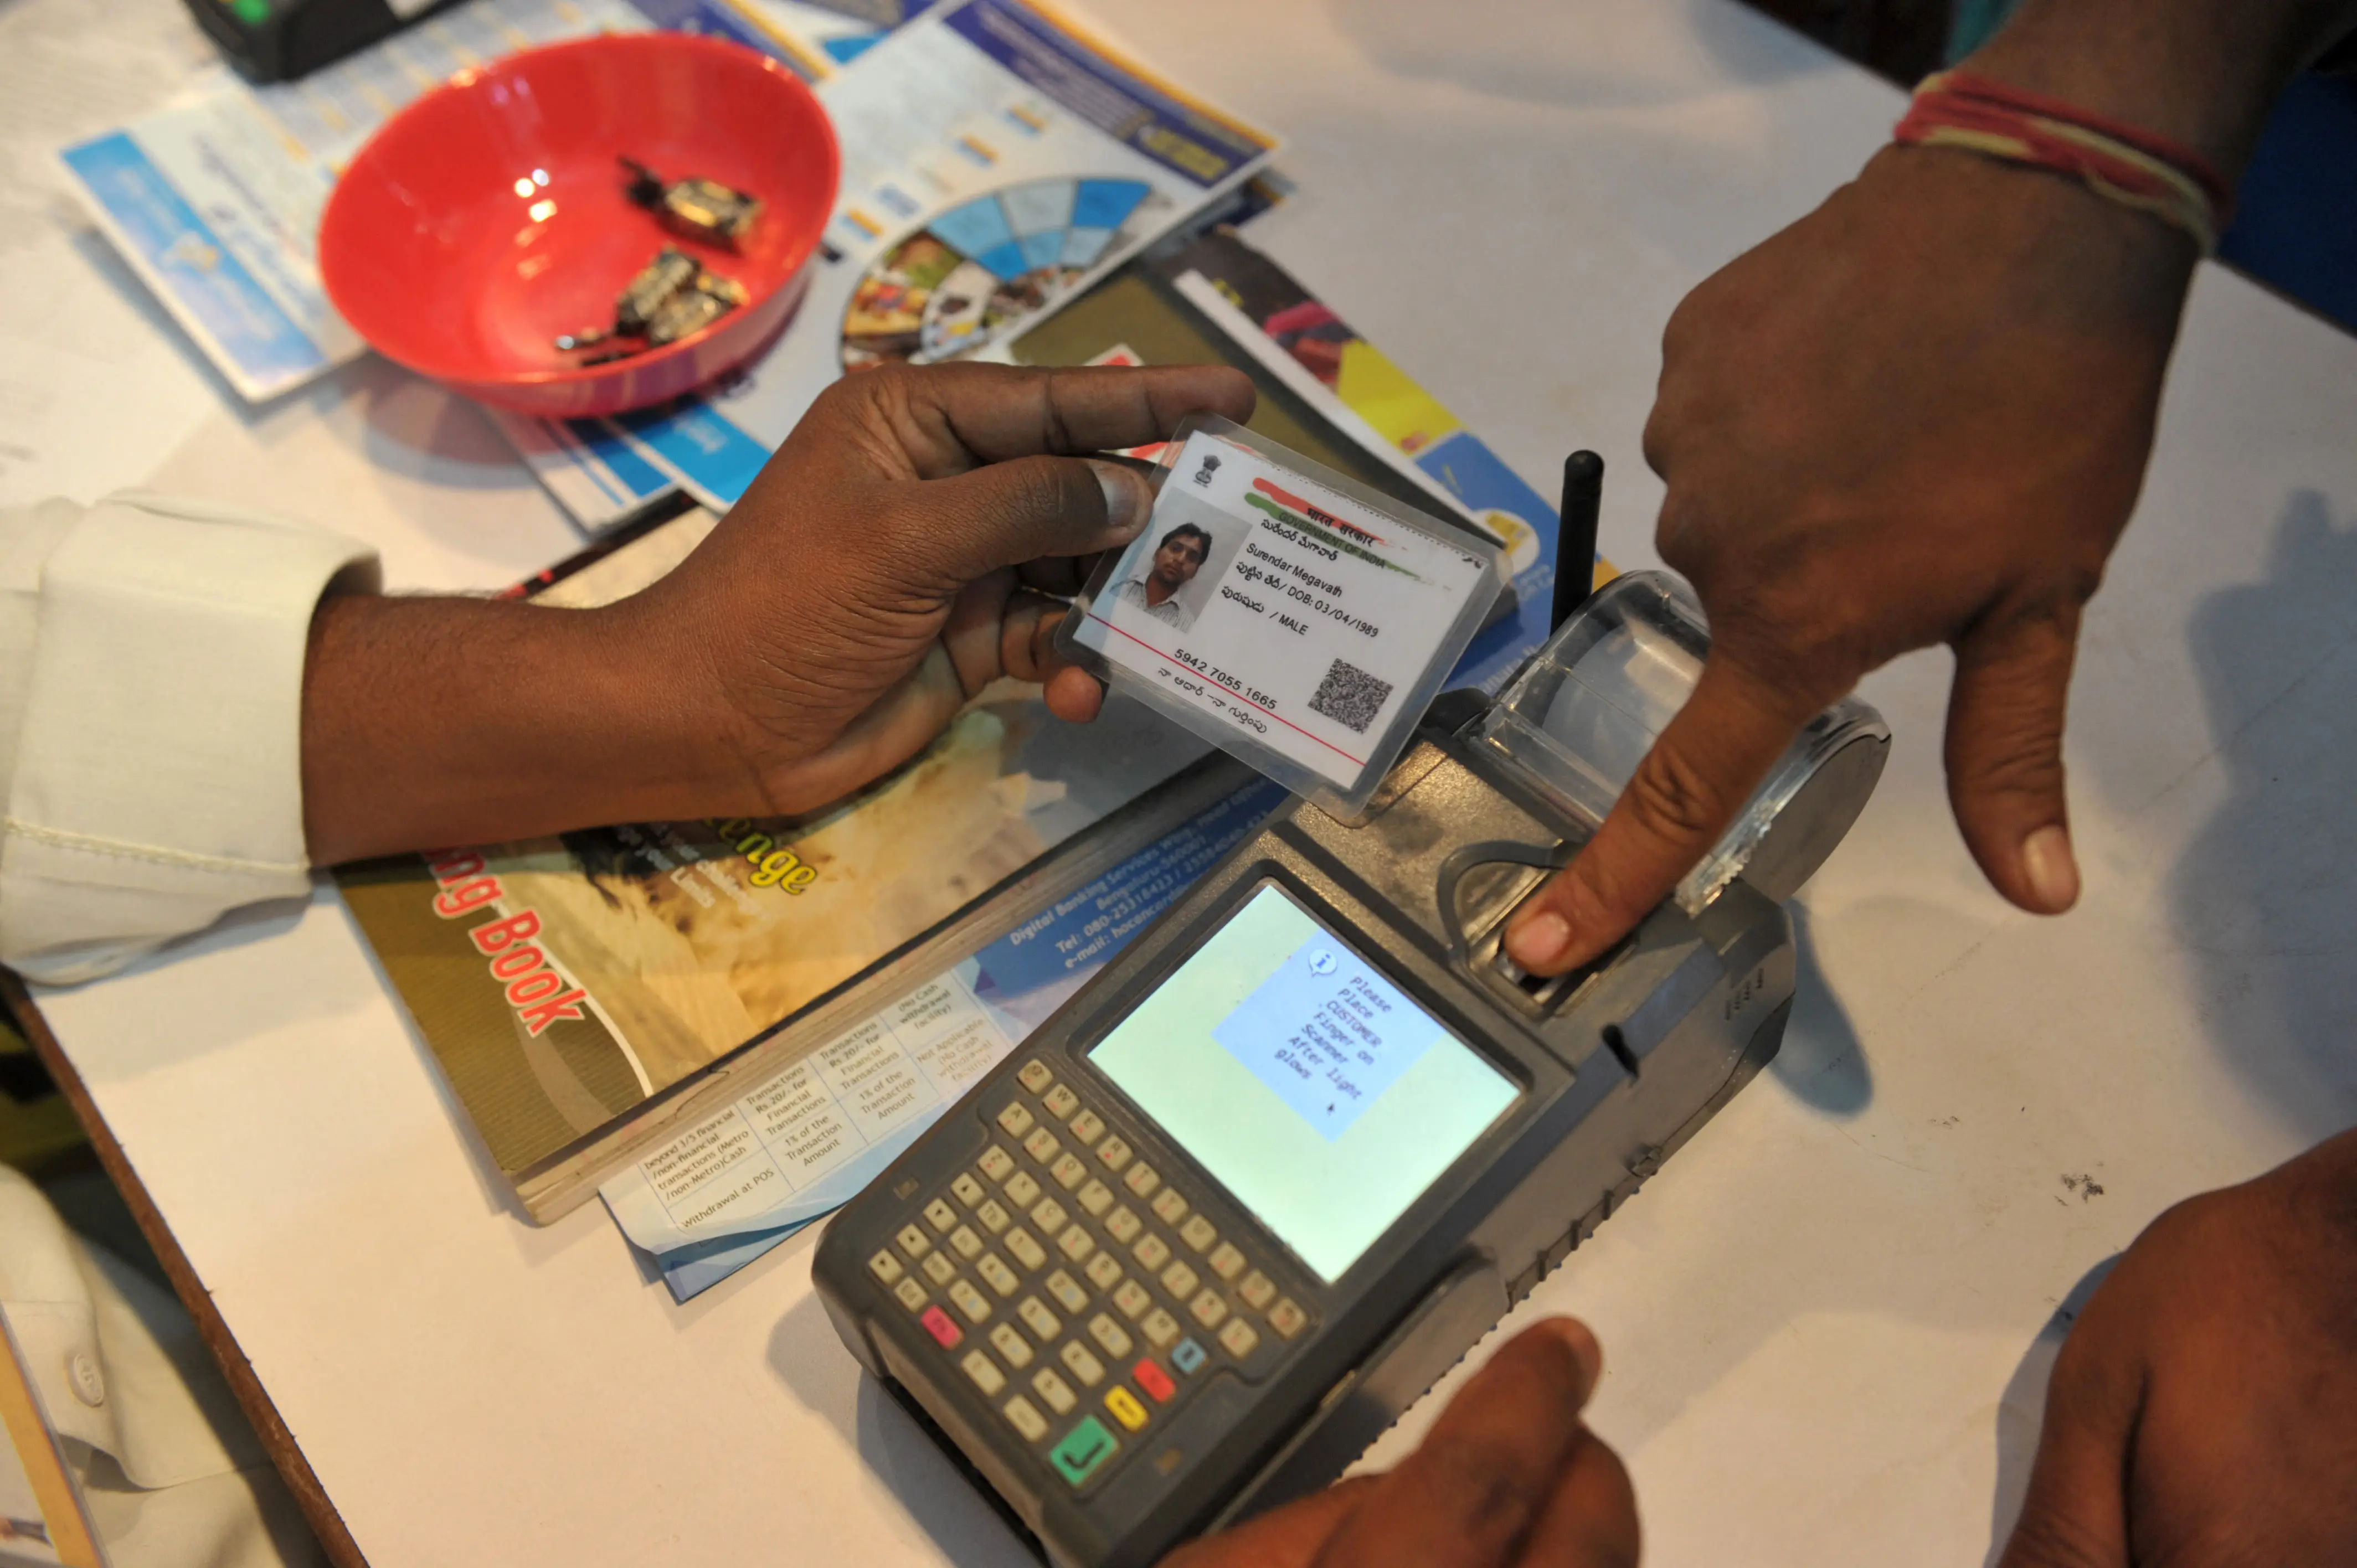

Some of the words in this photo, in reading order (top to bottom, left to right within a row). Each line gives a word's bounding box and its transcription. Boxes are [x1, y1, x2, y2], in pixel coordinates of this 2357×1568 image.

[1279, 512, 1346, 548] GOVERNMENT
[1345, 540, 1357, 554] OF
[1358, 548, 1386, 569] INDIA
[1308, 508, 1335, 527] भारत
[1340, 523, 1376, 548] सरकार
[1246, 543, 1293, 572] Surendar
[1292, 565, 1343, 598] Megavath
[1221, 585, 1265, 613] పురుషుడు
[1279, 614, 1309, 635] MALE
[1236, 561, 1263, 581] పుట్టిన
[1287, 585, 1314, 607] DOB:
[1314, 600, 1379, 637] 03/04/1989
[1158, 667, 1171, 677] నా
[1174, 676, 1205, 697] ఆధార్
[1174, 648, 1208, 672] 5942
[1210, 667, 1243, 690] 7055
[1246, 687, 1278, 709] 1665
[1009, 912, 1056, 946] Digital
[1055, 880, 1109, 917] Banking
[1107, 848, 1160, 885] Services
[1064, 936, 1111, 969] e-mail:
[469, 909, 587, 1038] Book
[915, 984, 939, 1000] Cash
[899, 989, 951, 1024] withdrawal
[1339, 988, 1373, 1018] Place
[1350, 977, 1392, 1012] Please
[914, 1003, 952, 1030] facility)
[1327, 1001, 1382, 1047] CUSTOMER
[820, 1023, 878, 1060] Transactions
[865, 1034, 880, 1045] for
[917, 1049, 936, 1063] Not
[935, 1019, 984, 1052] Applicable
[955, 1036, 979, 1053] Cash
[1289, 1037, 1324, 1065] After
[1302, 1024, 1348, 1063] Scanner
[1314, 1012, 1354, 1045] Finger
[1357, 1050, 1374, 1065] on
[840, 1045, 885, 1076] Financial
[840, 1052, 900, 1090] Transactions
[936, 1040, 994, 1077] withdrawal
[746, 1066, 804, 1105] Transactions
[792, 1078, 807, 1091] for
[860, 1089, 873, 1100] 1%
[874, 1080, 885, 1092] of
[885, 1071, 903, 1084] the
[861, 1077, 916, 1114] Transaction
[765, 1096, 826, 1136] Transactions
[766, 1089, 812, 1122] Financial
[878, 1093, 915, 1121] Amount
[644, 1145, 678, 1170] beyond
[696, 1110, 735, 1137] financial
[785, 1134, 799, 1147] 1%
[800, 1126, 810, 1138] of
[811, 1116, 830, 1129] the
[785, 1123, 842, 1160] Transaction
[652, 1133, 720, 1180] /non-financial
[658, 1152, 717, 1190] transactions
[718, 1130, 749, 1154] (Metro
[803, 1138, 841, 1167] Amount
[742, 1183, 753, 1194] at
[752, 1168, 775, 1186] POS
